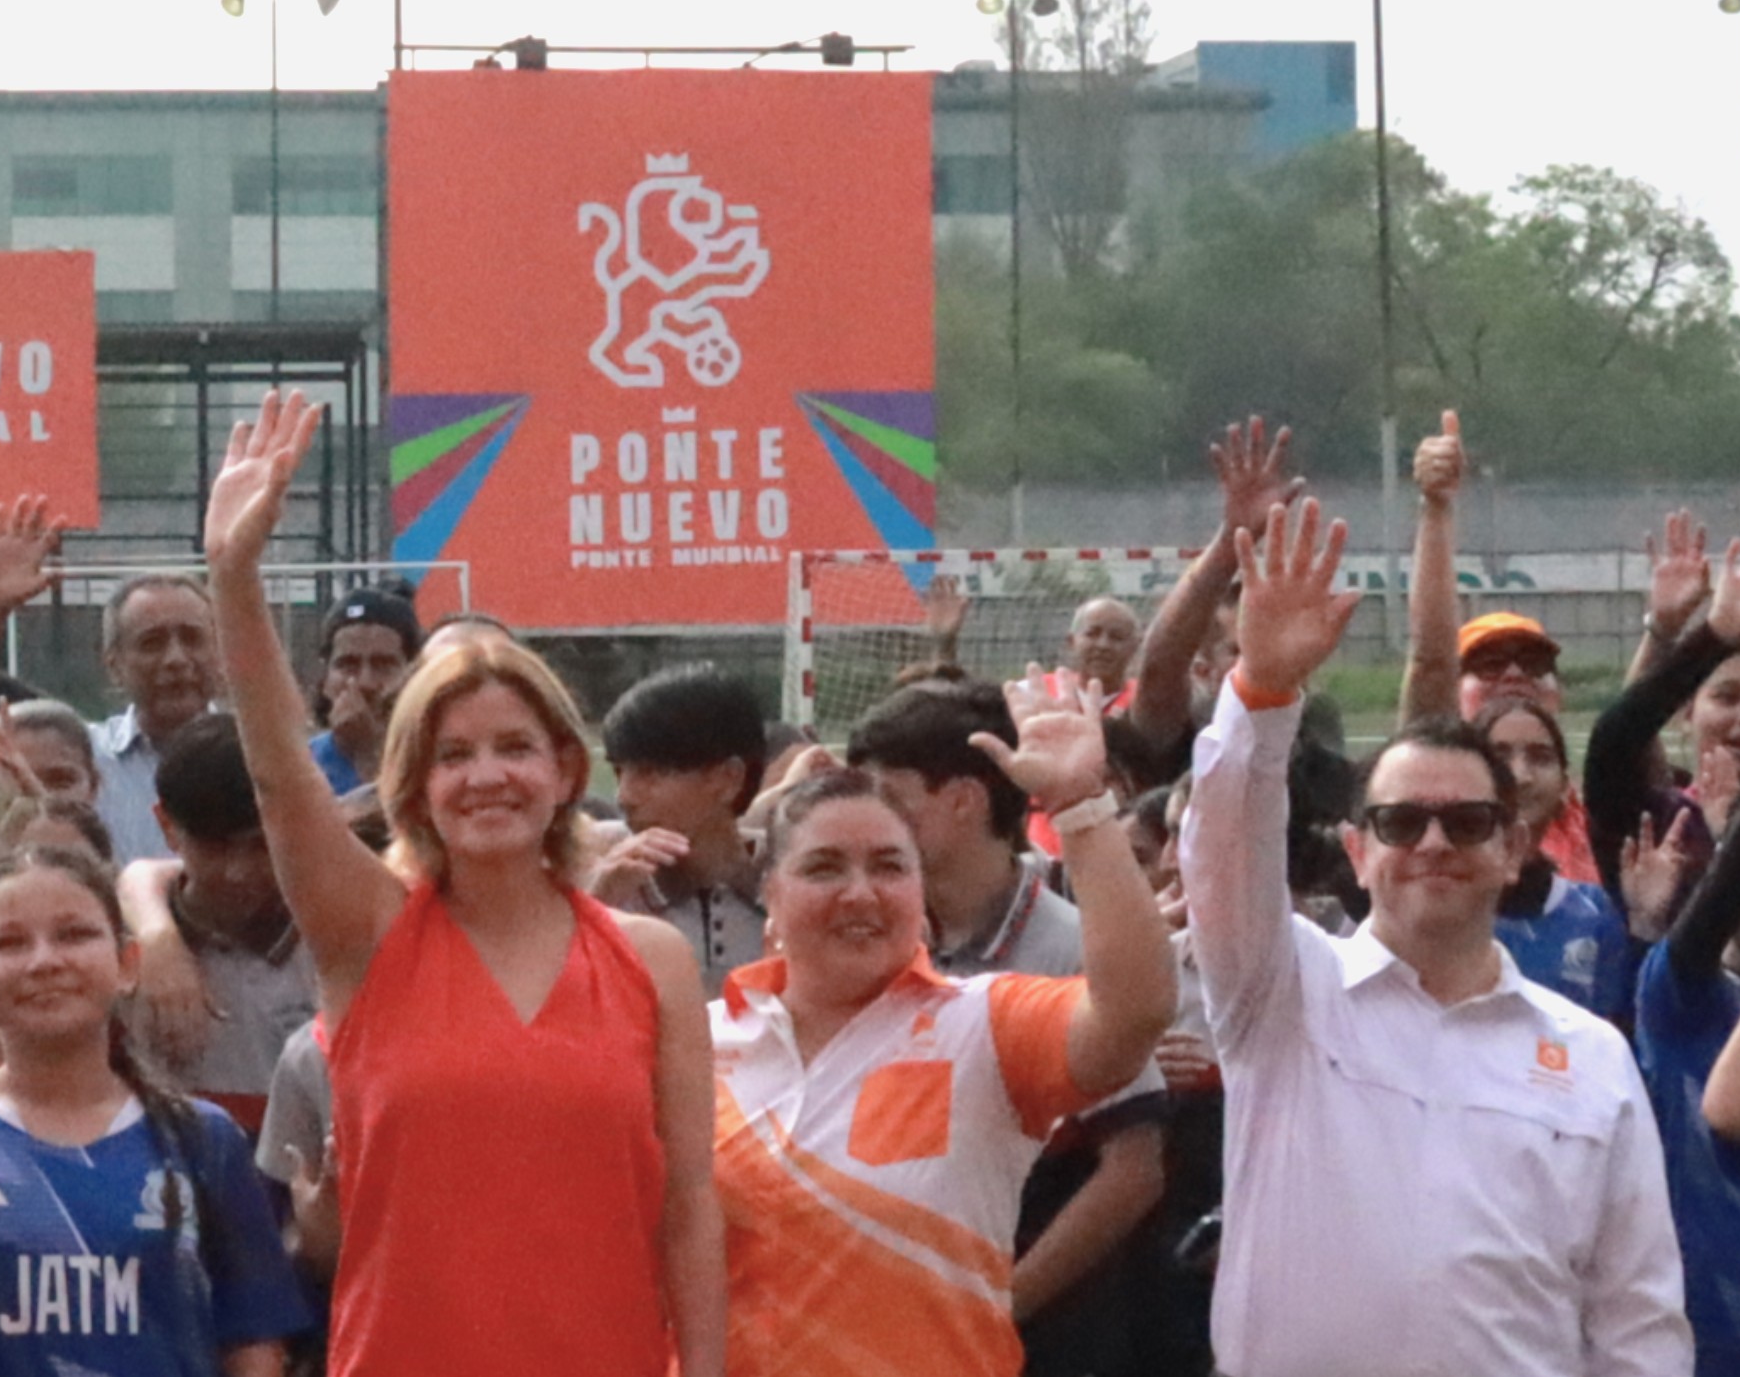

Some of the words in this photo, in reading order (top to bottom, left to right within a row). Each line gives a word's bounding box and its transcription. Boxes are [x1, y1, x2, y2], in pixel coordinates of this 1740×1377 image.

[571, 427, 784, 484] PONTE
[570, 488, 789, 545] NUEVO
[571, 549, 651, 567] PONTE
[672, 545, 782, 566] MUNDIAL
[0, 1255, 140, 1335] JATM
